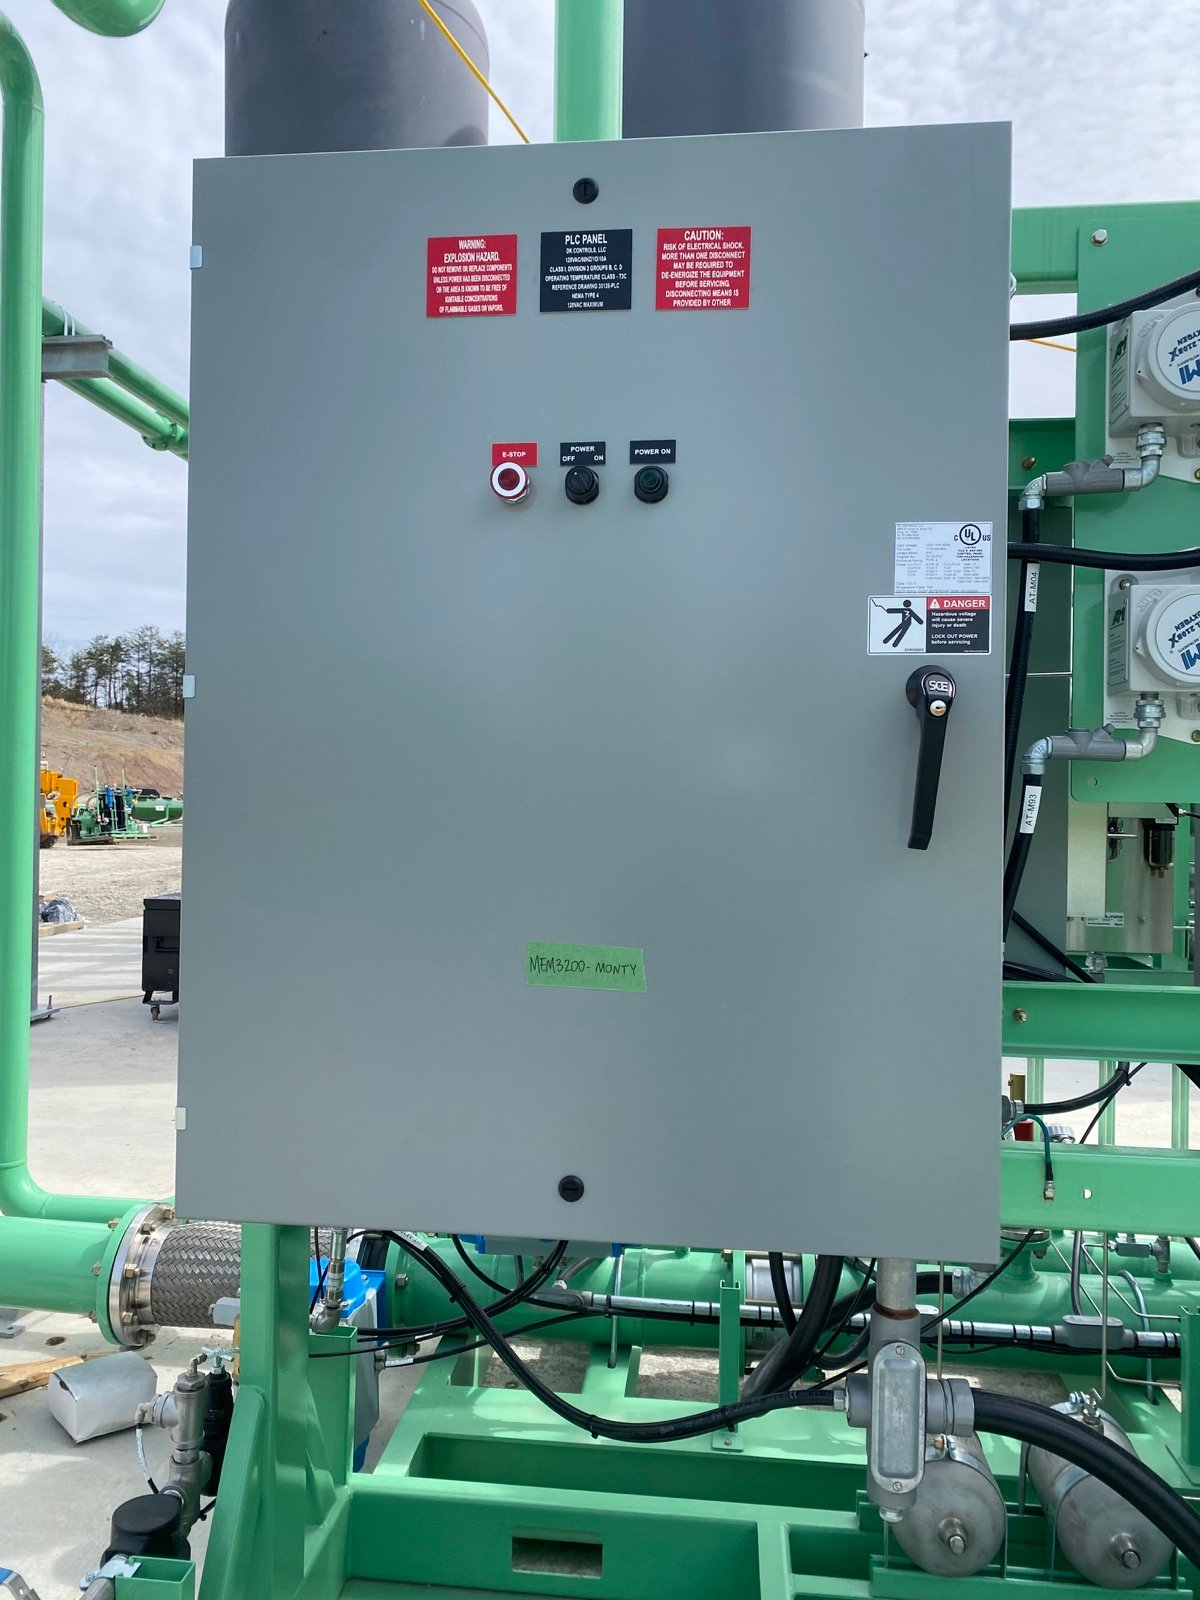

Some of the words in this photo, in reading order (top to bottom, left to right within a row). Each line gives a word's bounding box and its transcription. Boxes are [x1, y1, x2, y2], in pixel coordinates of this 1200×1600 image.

[565, 235, 580, 245] PLC
[583, 234, 607, 244] PANEL
[684, 230, 724, 240] CAUTION:
[459, 239, 486, 249] WARNING:
[444, 253, 475, 263] EXPLOSION
[476, 252, 500, 262] HAZARD.
[965, 529, 976, 541] UL
[1025, 794, 1037, 826] AT-M93
[530, 955, 591, 973] MEM3200-
[596, 962, 636, 975] MONTY
